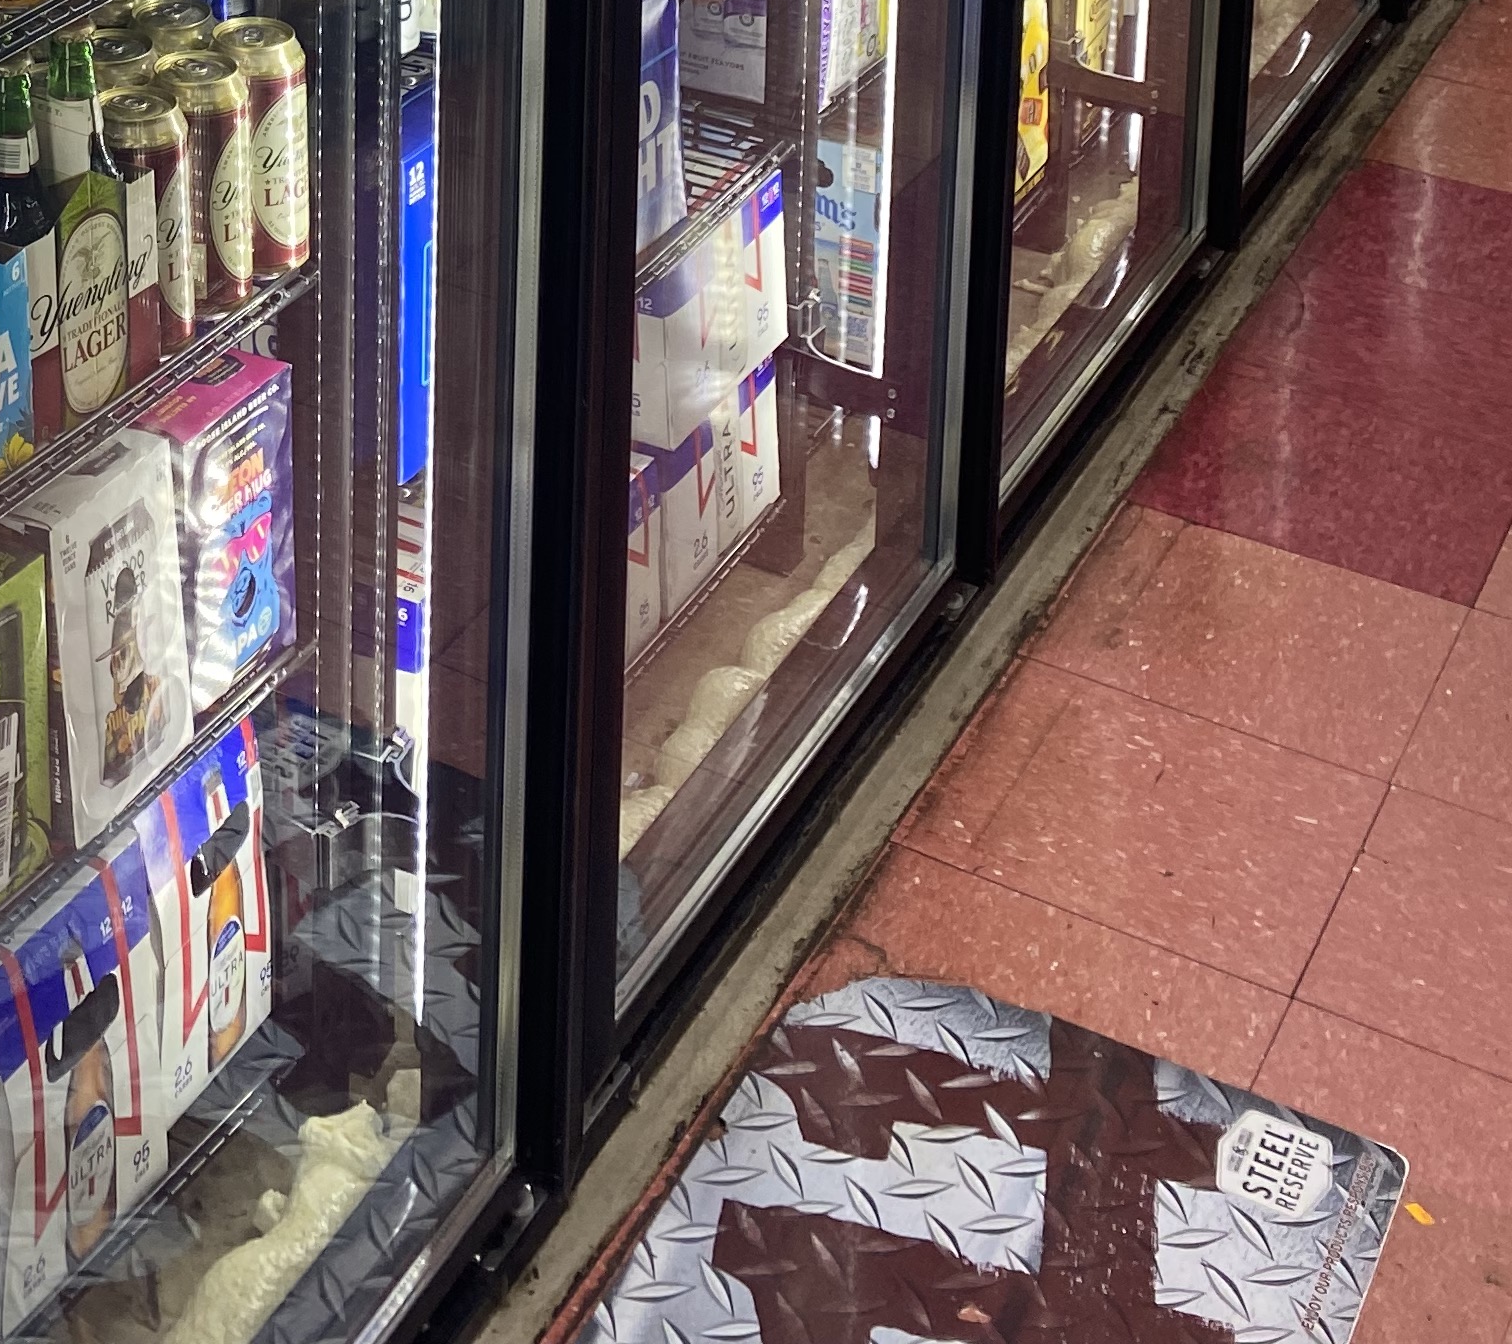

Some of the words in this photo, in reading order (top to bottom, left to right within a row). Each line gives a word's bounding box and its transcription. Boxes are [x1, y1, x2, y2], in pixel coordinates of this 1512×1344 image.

[11, 261, 20, 281] 6
[30, 234, 154, 352] Yuengling
[62, 311, 126, 374] LAGER
[220, 408, 247, 433] ISLAND
[247, 393, 268, 416] BEER
[99, 915, 113, 937] 12
[119, 894, 134, 915] 12
[210, 949, 245, 998] ULTRA
[69, 1138, 114, 1190] ULTRA
[1242, 1123, 1296, 1200] STEEL
[1274, 1136, 1320, 1212] RESERVE
[1301, 1295, 1323, 1331] ENJOY
[1315, 1272, 1331, 1295] OUR
